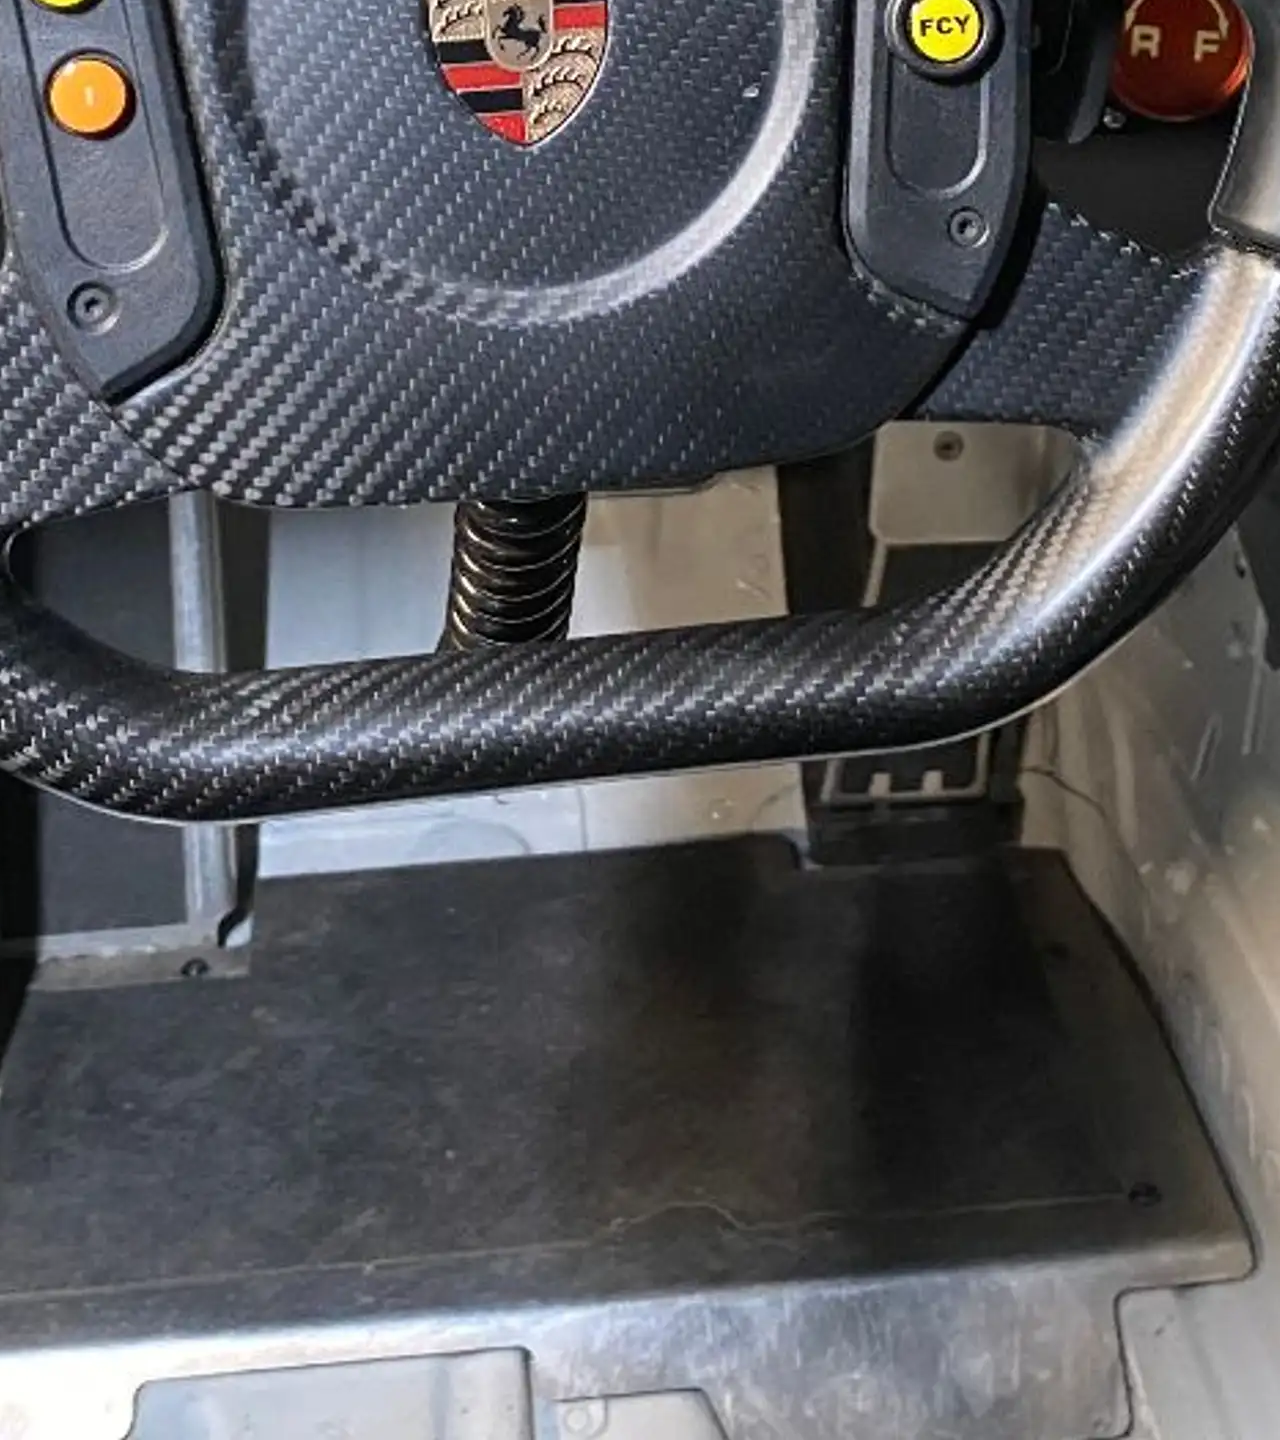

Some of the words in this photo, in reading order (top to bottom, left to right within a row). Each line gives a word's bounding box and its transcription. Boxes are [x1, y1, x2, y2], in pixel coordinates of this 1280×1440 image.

[919, 14, 971, 38] FCY
[1130, 24, 1162, 59] R
[1194, 29, 1221, 63] F
